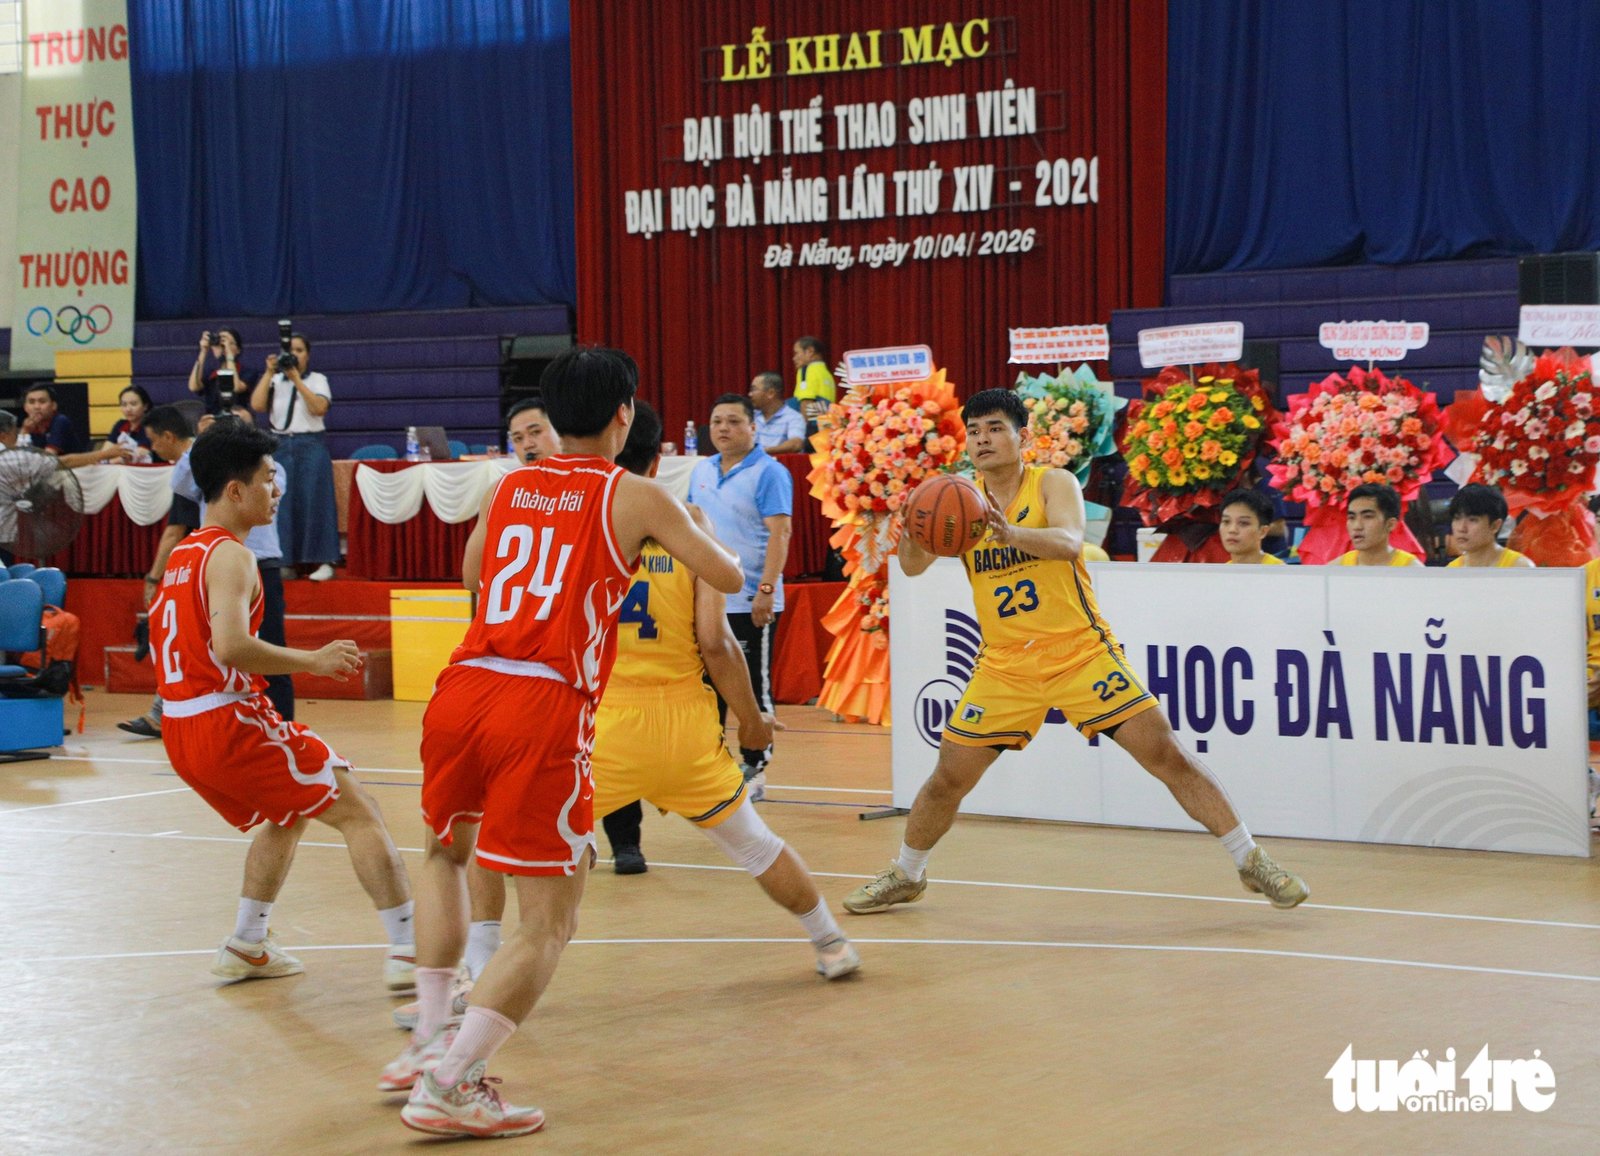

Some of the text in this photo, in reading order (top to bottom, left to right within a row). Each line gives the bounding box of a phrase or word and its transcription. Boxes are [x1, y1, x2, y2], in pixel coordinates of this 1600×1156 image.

[29, 24, 128, 66] TRUNG
[721, 18, 989, 81] LỄ KHAI MẠC
[36, 97, 115, 148] THỰC
[683, 115, 722, 167] ĐẠI
[733, 103, 771, 164] HỘI
[833, 101, 896, 150] THAO
[908, 92, 967, 144] SINH
[976, 78, 1036, 137] VIÊN
[49, 175, 111, 214] CAO
[625, 188, 663, 240] ĐẠI
[670, 184, 715, 237] HỌC
[725, 174, 756, 227] ĐÀ
[764, 166, 828, 225] NẴNG
[893, 160, 943, 217] THỨ
[952, 164, 994, 212] XIV
[19, 248, 128, 297] THƯỢNG
[763, 242, 792, 268] Đà
[799, 238, 854, 270] Nẵng,
[858, 237, 910, 268] ngày
[511, 487, 585, 515] Hoàng Hải
[485, 524, 573, 625] 24
[649, 555, 673, 574] KHOA
[994, 579, 1039, 618] 23
[162, 599, 183, 684] 2
[1093, 671, 1130, 702] 23
[1147, 645, 1254, 753] HỌC
[1275, 630, 1354, 740] ĐÀ
[1373, 617, 1547, 749] NẴNG
